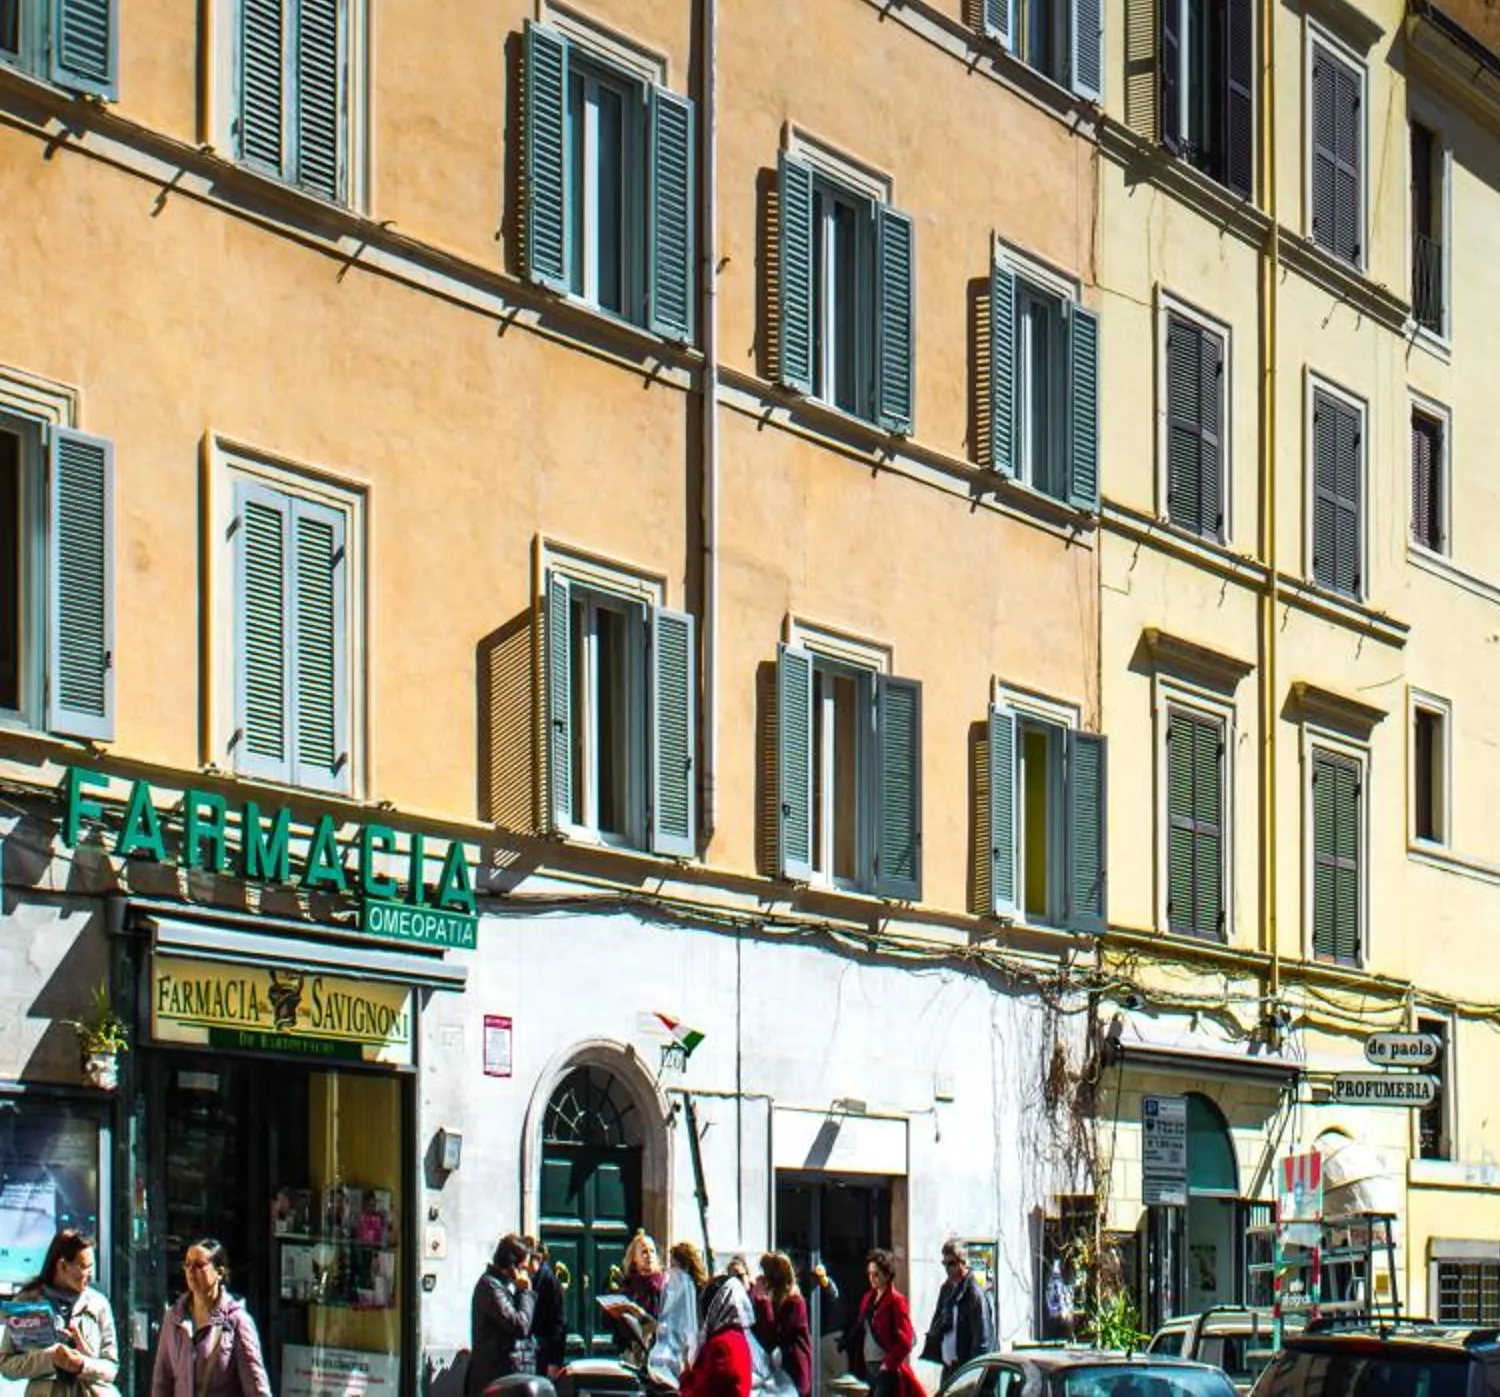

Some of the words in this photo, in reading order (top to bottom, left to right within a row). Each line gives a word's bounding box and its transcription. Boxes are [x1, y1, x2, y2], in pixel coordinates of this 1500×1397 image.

[62, 765, 477, 914] FARMACIA
[369, 906, 475, 944] OMEOPATIA
[157, 975, 260, 1021] FARMACIA
[311, 977, 409, 1038] SAVIGNONI
[1369, 1039, 1386, 1055] de
[1391, 1039, 1433, 1059] paola
[1336, 1081, 1430, 1099] PROFUMERIA
